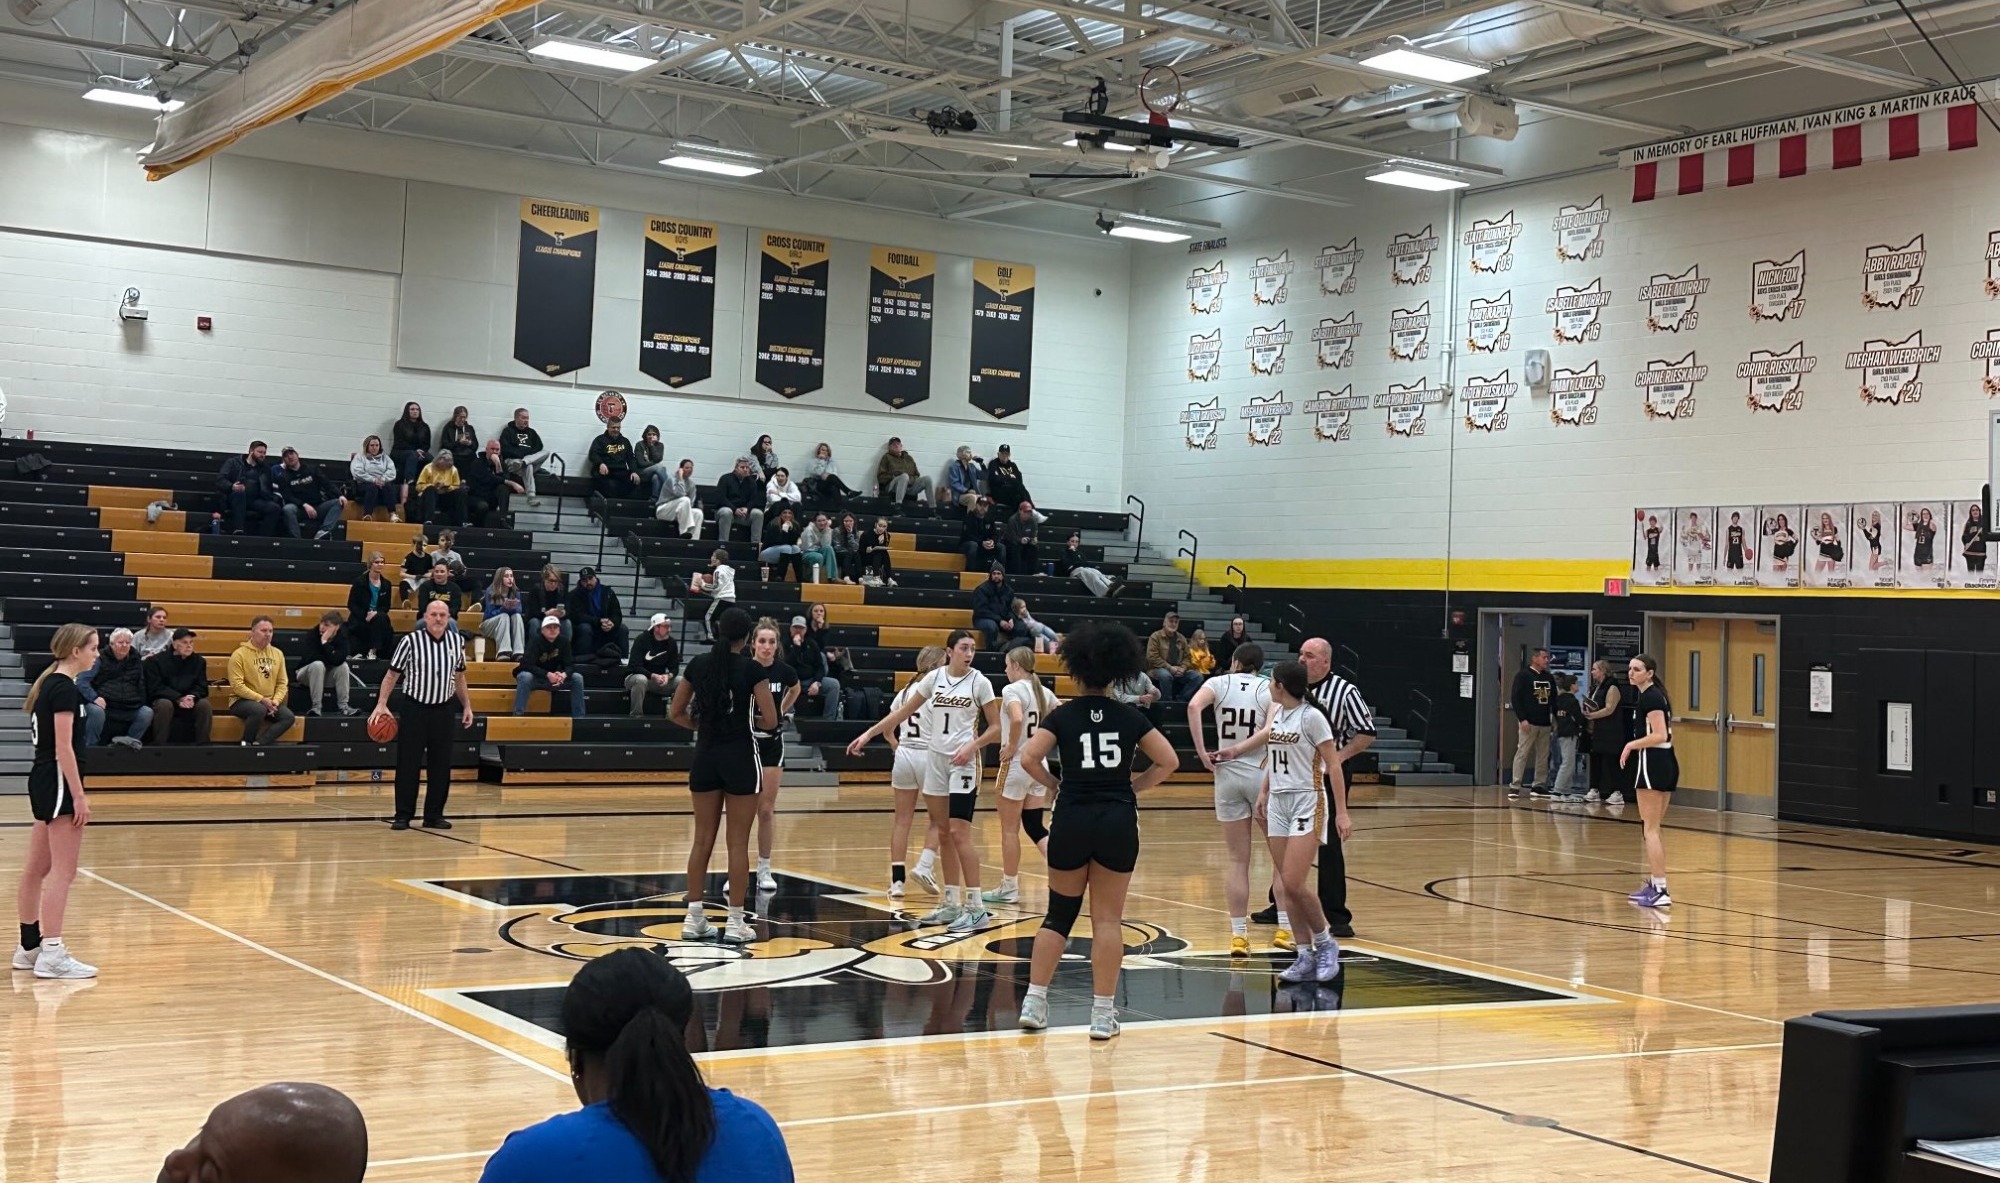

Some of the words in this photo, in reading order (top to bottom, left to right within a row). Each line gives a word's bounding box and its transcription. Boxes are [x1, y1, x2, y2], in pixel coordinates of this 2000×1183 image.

[1633, 149, 1645, 162] IN
[1647, 139, 1692, 159] MEMORY
[1694, 136, 1709, 150] OF
[1712, 131, 1738, 147] EARL
[1741, 117, 1799, 142] HUFFMAN,
[1802, 113, 1832, 130] IVAN
[1835, 107, 1866, 125] KING
[1869, 105, 1877, 118] &
[1880, 95, 1929, 116] MARTIN
[531, 203, 590, 223] CHEERLEADING
[1553, 215, 1574, 231] STATE
[1573, 209, 1610, 227] QUALIFIER
[651, 220, 676, 234] CROSS
[677, 224, 713, 239] COUNTRY
[767, 235, 791, 249] CROSS
[792, 238, 825, 253] COUNTRY
[887, 252, 919, 267] FOOTBALL
[1863, 256, 1891, 274] ABBY
[1890, 251, 1927, 271] RAPIEN
[998, 267, 1012, 278] GOLF
[1757, 270, 1781, 287] NICK
[1780, 266, 1800, 285] FOX
[1639, 282, 1675, 301] ISABELLE
[1674, 278, 1710, 298] MURRAY
[1907, 286, 1924, 306] '17
[1578, 291, 1611, 310] MURRAY
[1788, 299, 1806, 318] '17
[1683, 312, 1698, 330] '16
[1888, 346, 1941, 367] WERBRICH
[1635, 370, 1665, 388] CORINE
[1664, 365, 1708, 386] RIESKAMP
[1736, 361, 1769, 378] CORINE
[1768, 356, 1817, 377] RIESKAMP
[1784, 391, 1804, 410] '24
[1902, 382, 1923, 402] '24
[1678, 399, 1695, 418] '24
[933, 691, 973, 708] Jackets
[942, 712, 950, 735] 1
[1221, 707, 1256, 740] 24
[1079, 732, 1122, 769] 15
[1272, 749, 1289, 775] 14
[961, 775, 972, 789] T
